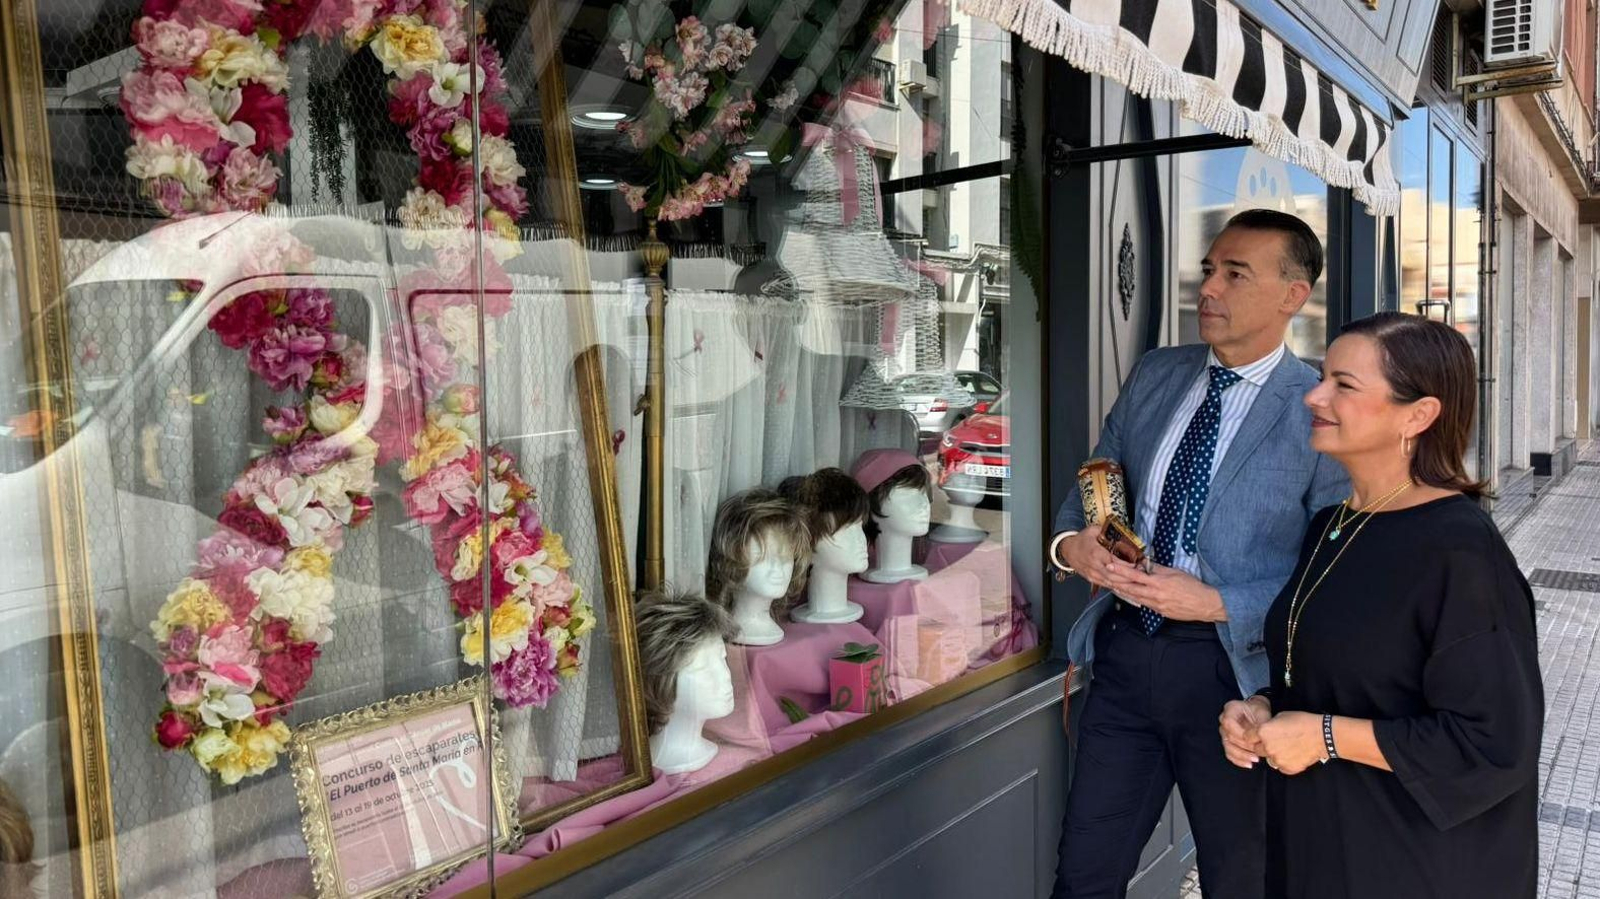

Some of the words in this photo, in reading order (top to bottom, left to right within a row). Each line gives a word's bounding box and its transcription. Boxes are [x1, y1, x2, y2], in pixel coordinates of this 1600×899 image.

[323, 760, 383, 787] Concurso
[386, 753, 401, 765] de
[405, 730, 476, 760] escaparates
[343, 778, 381, 796] Puerto
[383, 770, 397, 784] de
[400, 760, 430, 777] Santa
[463, 744, 475, 756] en
[330, 809, 344, 821] del
[344, 807, 353, 816] 13
[354, 802, 363, 813] al
[373, 796, 384, 806] de
[385, 787, 415, 803] octure
